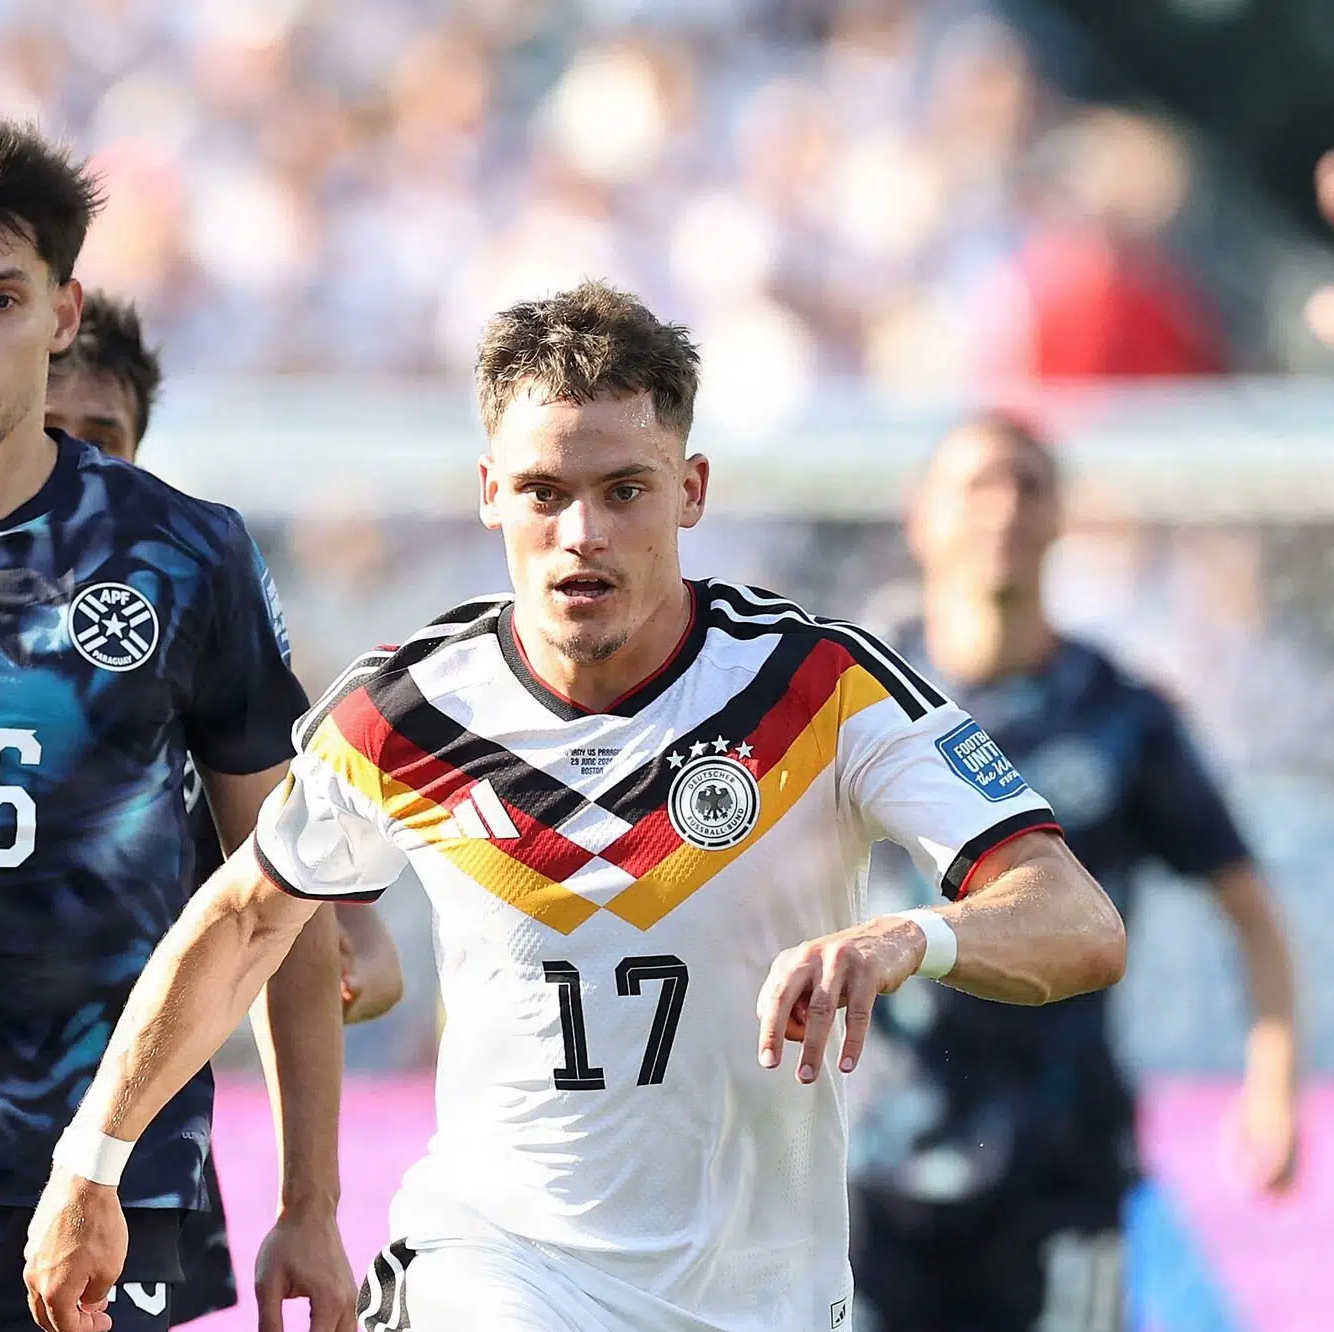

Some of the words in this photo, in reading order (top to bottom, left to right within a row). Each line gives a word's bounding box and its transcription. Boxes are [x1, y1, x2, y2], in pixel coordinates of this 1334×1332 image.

[99, 589, 130, 605] APF
[92, 650, 132, 665] PARAGUAY
[580, 757, 596, 766] JUNE
[962, 740, 1004, 773] UNIT
[580, 767, 604, 775] BOSTON
[974, 770, 997, 786] the
[687, 770, 736, 790] DEUTSCHER
[687, 807, 744, 836] FUSSBALL-BUND
[542, 954, 690, 1091] 17
